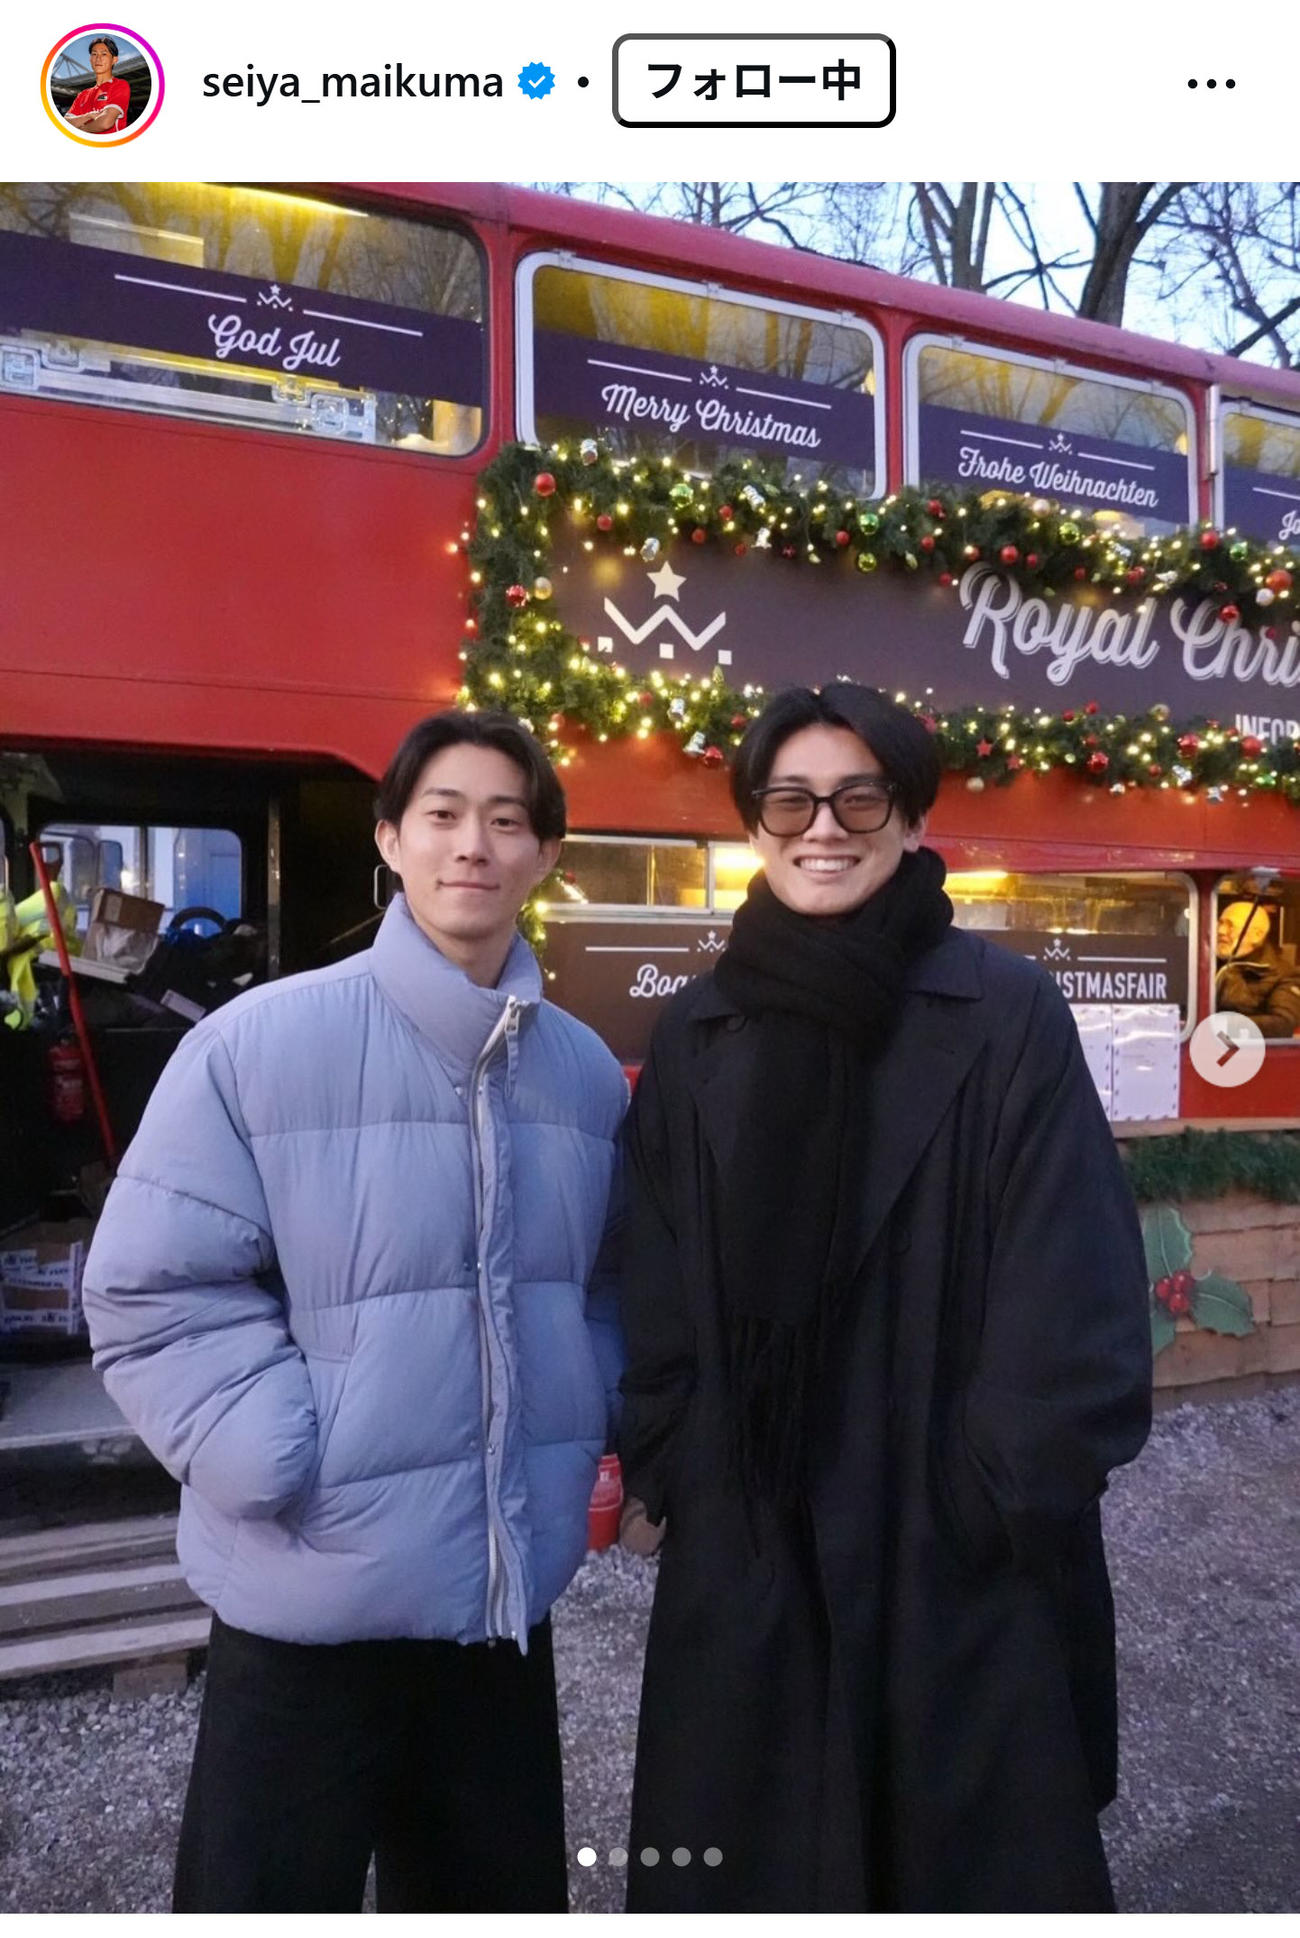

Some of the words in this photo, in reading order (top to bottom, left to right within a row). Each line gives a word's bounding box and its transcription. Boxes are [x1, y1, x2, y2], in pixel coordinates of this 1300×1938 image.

[208, 314, 281, 358] God
[282, 330, 340, 371] Jul
[602, 384, 691, 433] Merry
[696, 399, 821, 448] Christmas
[958, 446, 1026, 484] Frohe
[1029, 461, 1159, 508] Weihnachten
[959, 561, 1160, 686] Royal
